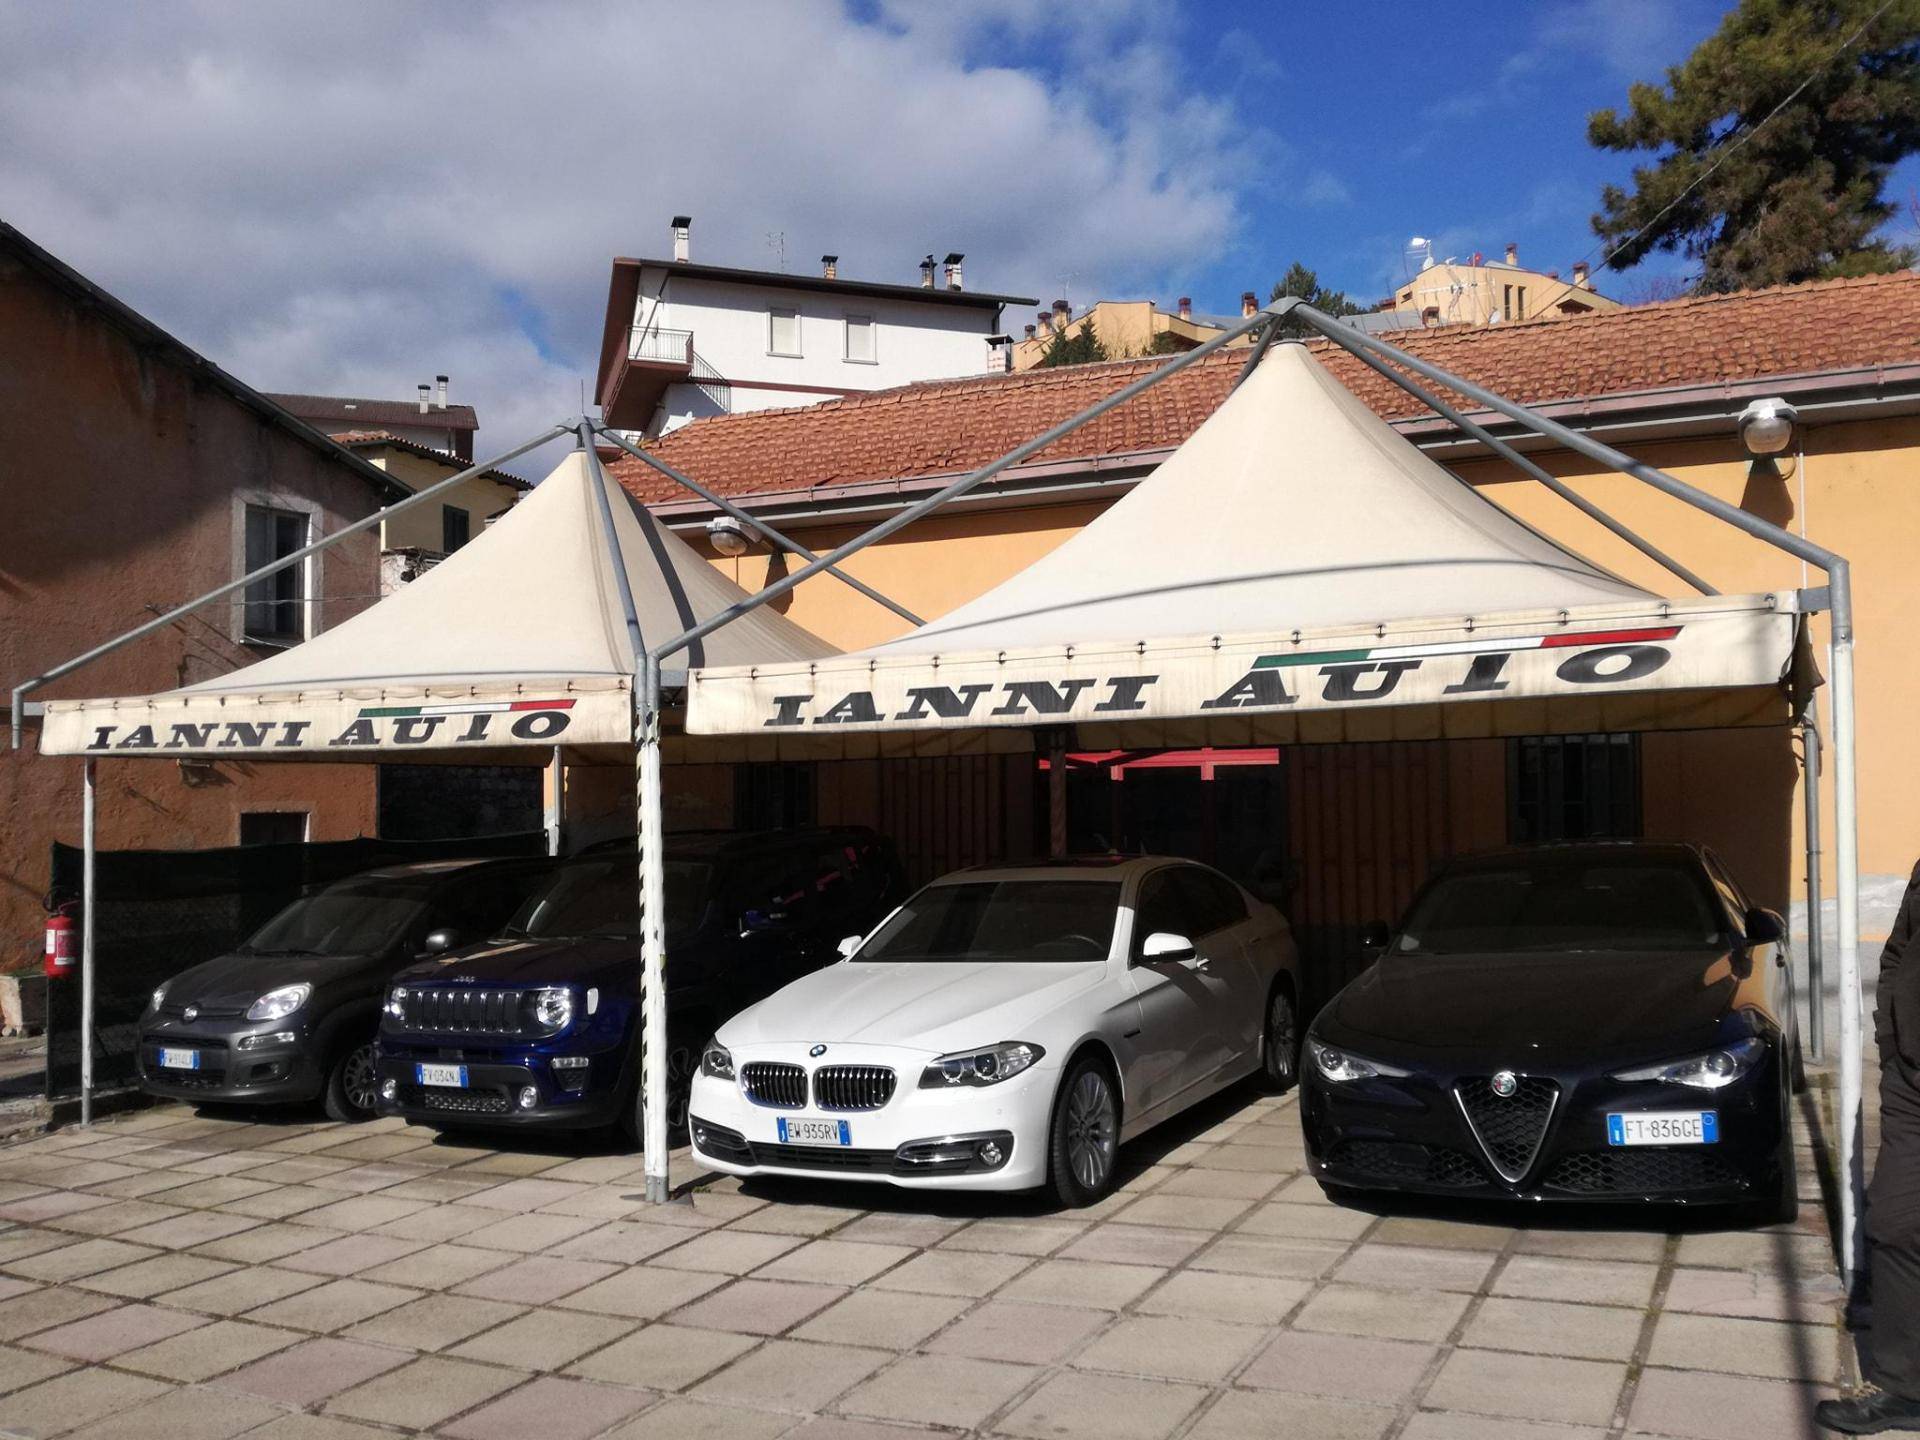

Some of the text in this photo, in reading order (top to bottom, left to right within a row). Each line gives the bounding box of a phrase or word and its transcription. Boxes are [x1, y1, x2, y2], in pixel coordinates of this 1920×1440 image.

[764, 675, 1160, 726] IANNI
[87, 720, 312, 750] IANNI
[803, 1123, 838, 1140] 935RV
